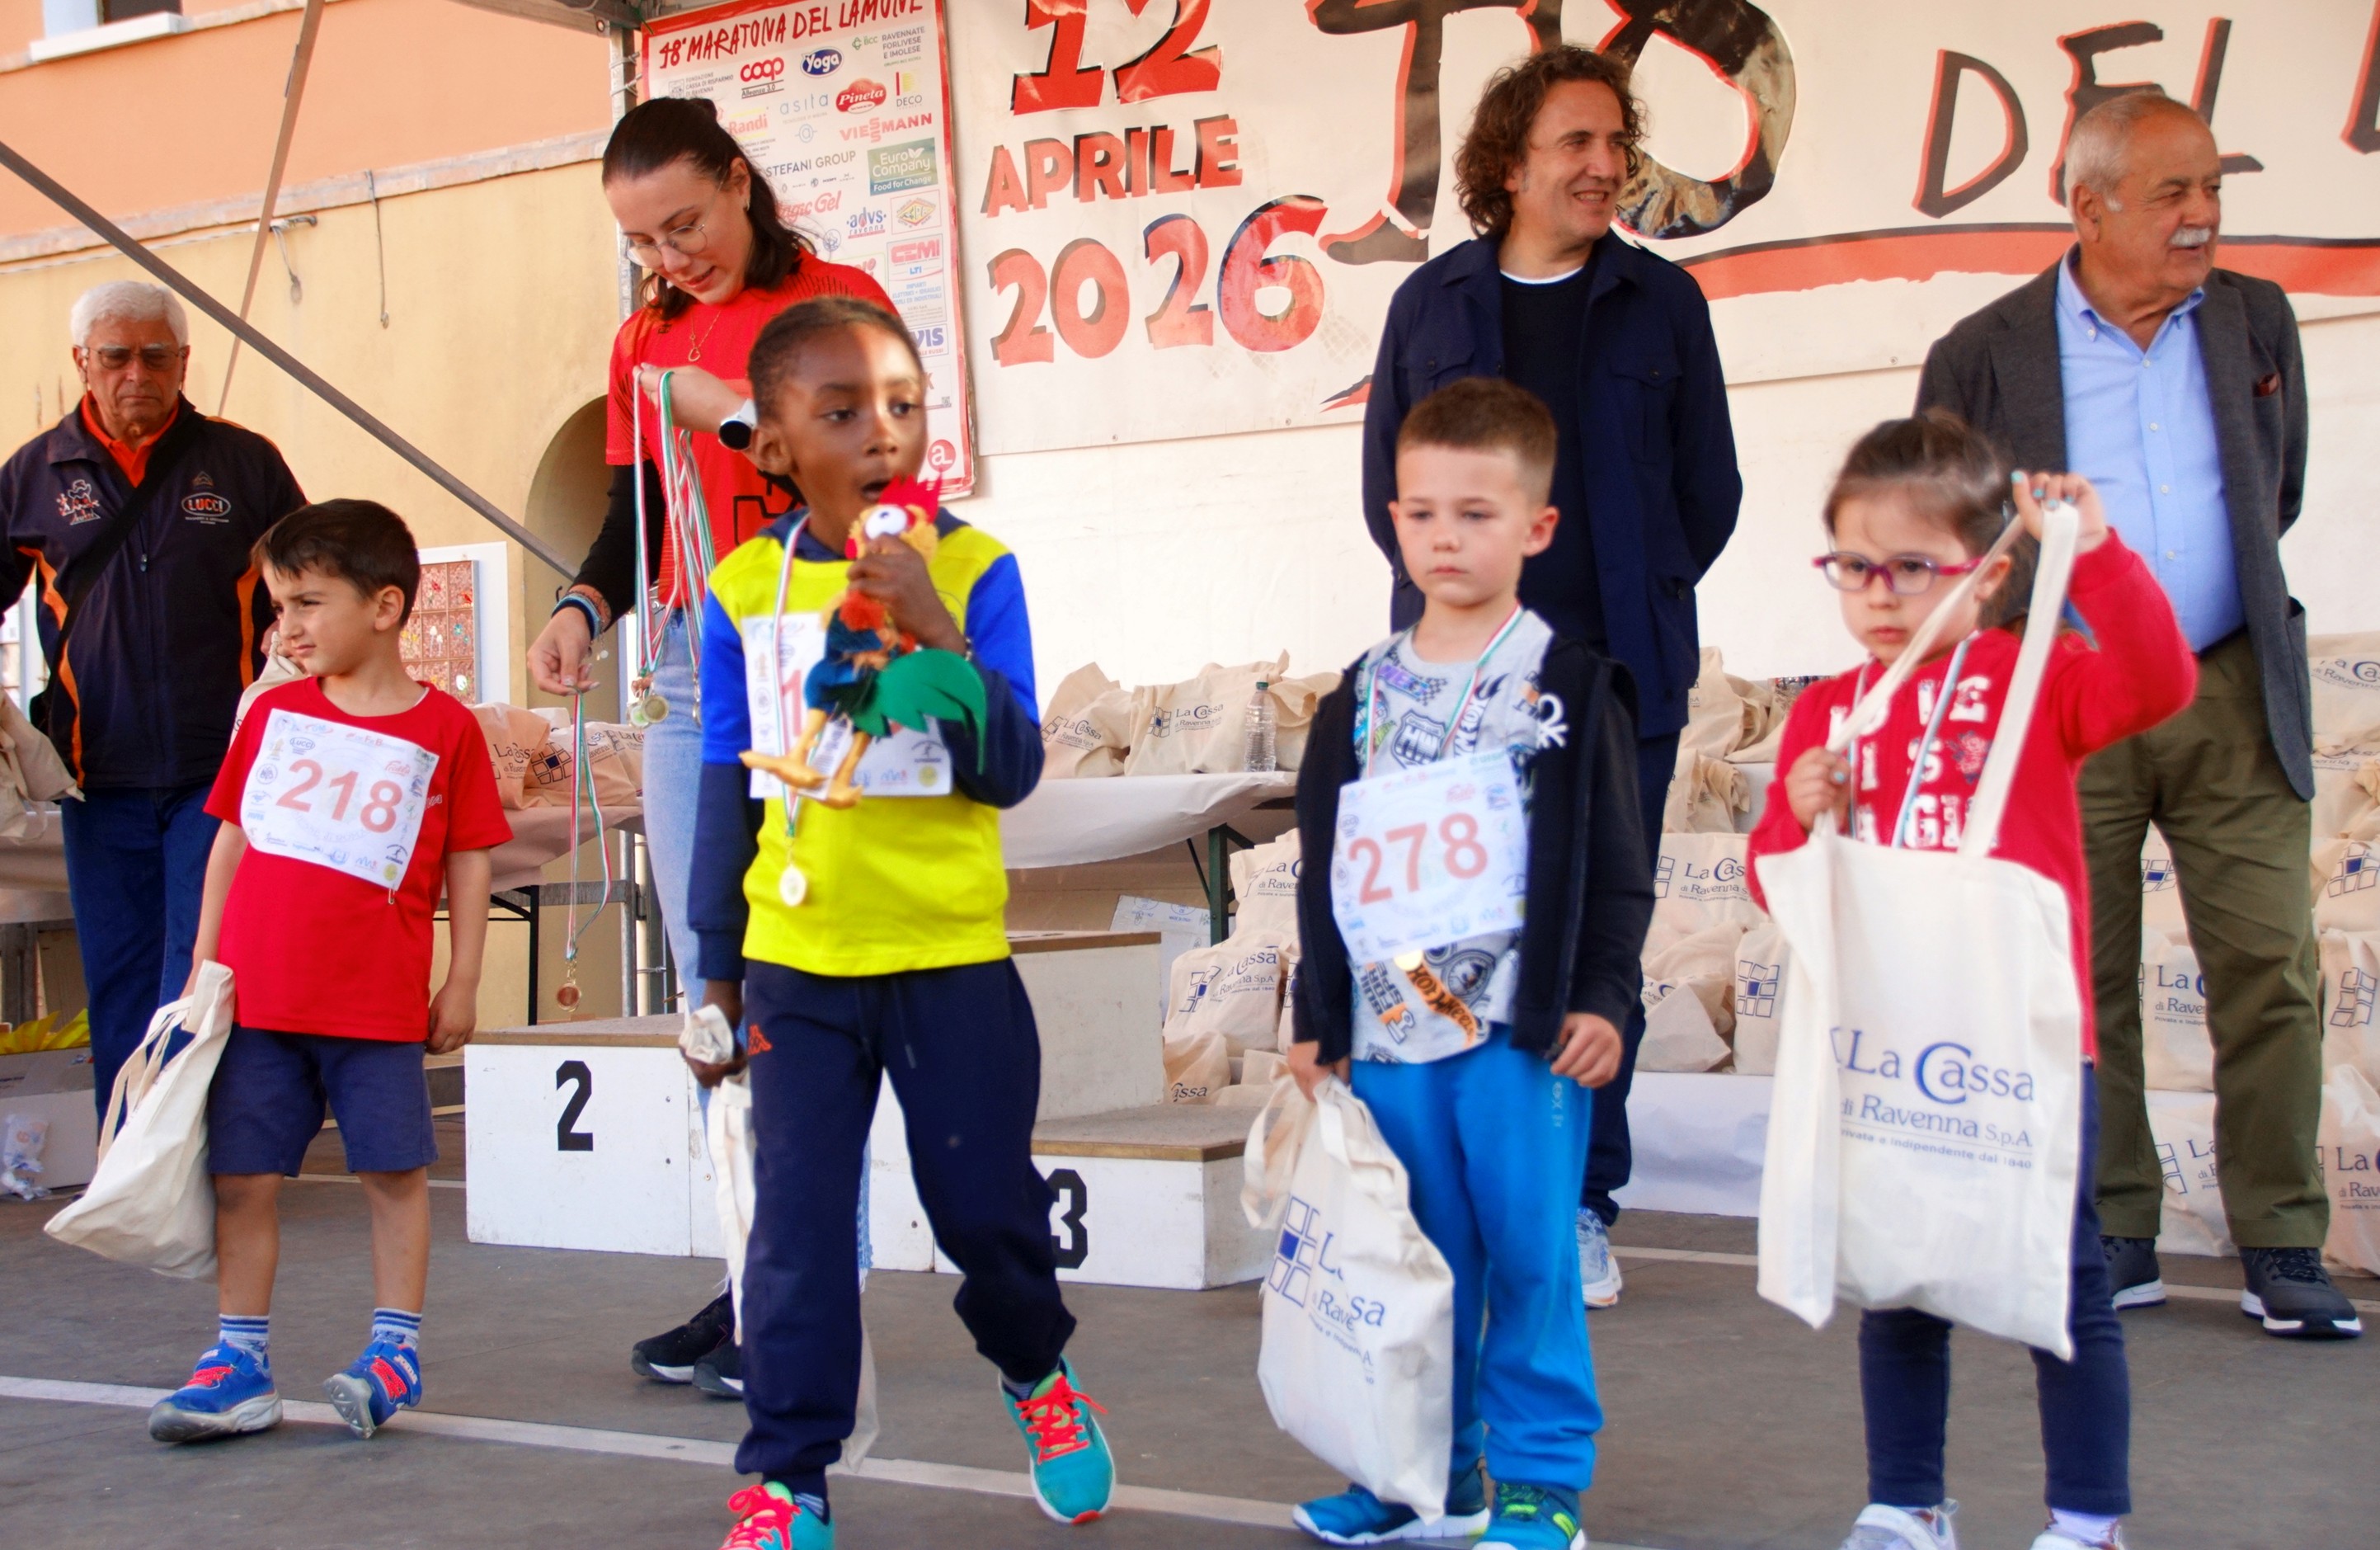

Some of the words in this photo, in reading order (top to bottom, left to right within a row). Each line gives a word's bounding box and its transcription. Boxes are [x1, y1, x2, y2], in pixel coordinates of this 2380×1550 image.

[687, 12, 786, 62] MARATONA
[793, 7, 832, 39] DEL
[882, 26, 925, 41] RAVENNATE
[882, 35, 922, 50] FORLIVESE
[890, 45, 921, 58] IMOLESE
[1011, 0, 1222, 115] 12
[741, 57, 784, 82] coop
[806, 53, 840, 73] Yoga
[780, 93, 829, 115] asita
[839, 89, 885, 106] Pineta
[896, 95, 923, 107] DECO
[729, 114, 768, 135] Randi
[766, 159, 812, 178] STEFANI
[816, 150, 856, 169] GROUP
[873, 158, 930, 177] Company
[880, 151, 908, 165] Euro
[981, 114, 1243, 218] APRILE
[874, 181, 892, 191] Food
[892, 179, 904, 188] for
[905, 176, 932, 187] Change
[778, 199, 811, 224] agic
[815, 191, 841, 214] Gel
[849, 224, 885, 236] ravenna
[987, 194, 1329, 368] 2026
[909, 327, 943, 347] VIS
[188, 498, 223, 512] LUCCI
[1176, 709, 1191, 718] La
[1194, 704, 1224, 719] Cassa
[1064, 719, 1075, 729] La
[1075, 720, 1102, 740] Cassa
[493, 743, 513, 757] La
[275, 758, 402, 834] 218
[1266, 862, 1286, 873] La
[1348, 813, 1489, 907] 278
[1685, 863, 1710, 879] La
[1714, 857, 1746, 882] Cas
[1268, 878, 1298, 889] Rave
[1681, 884, 1688, 893] di
[1691, 883, 1739, 896] Ravenna
[2157, 964, 2190, 989] La
[2155, 1002, 2164, 1011] di
[2167, 997, 2205, 1015] Rave
[1845, 1029, 1900, 1079] La
[1914, 1041, 2034, 1105] Cassa
[555, 1060, 594, 1152] 2
[1860, 1094, 1978, 1138] Ravenna
[1984, 1124, 2034, 1149] S.p.A.
[1841, 1127, 1874, 1142] rivata
[1978, 1152, 1998, 1164] dal
[2003, 1157, 2032, 1170] 1840
[2335, 1147, 2369, 1171] La
[2198, 1170, 2208, 1179] di
[1050, 1168, 1088, 1269] 3
[1319, 1289, 1355, 1332] Rave
